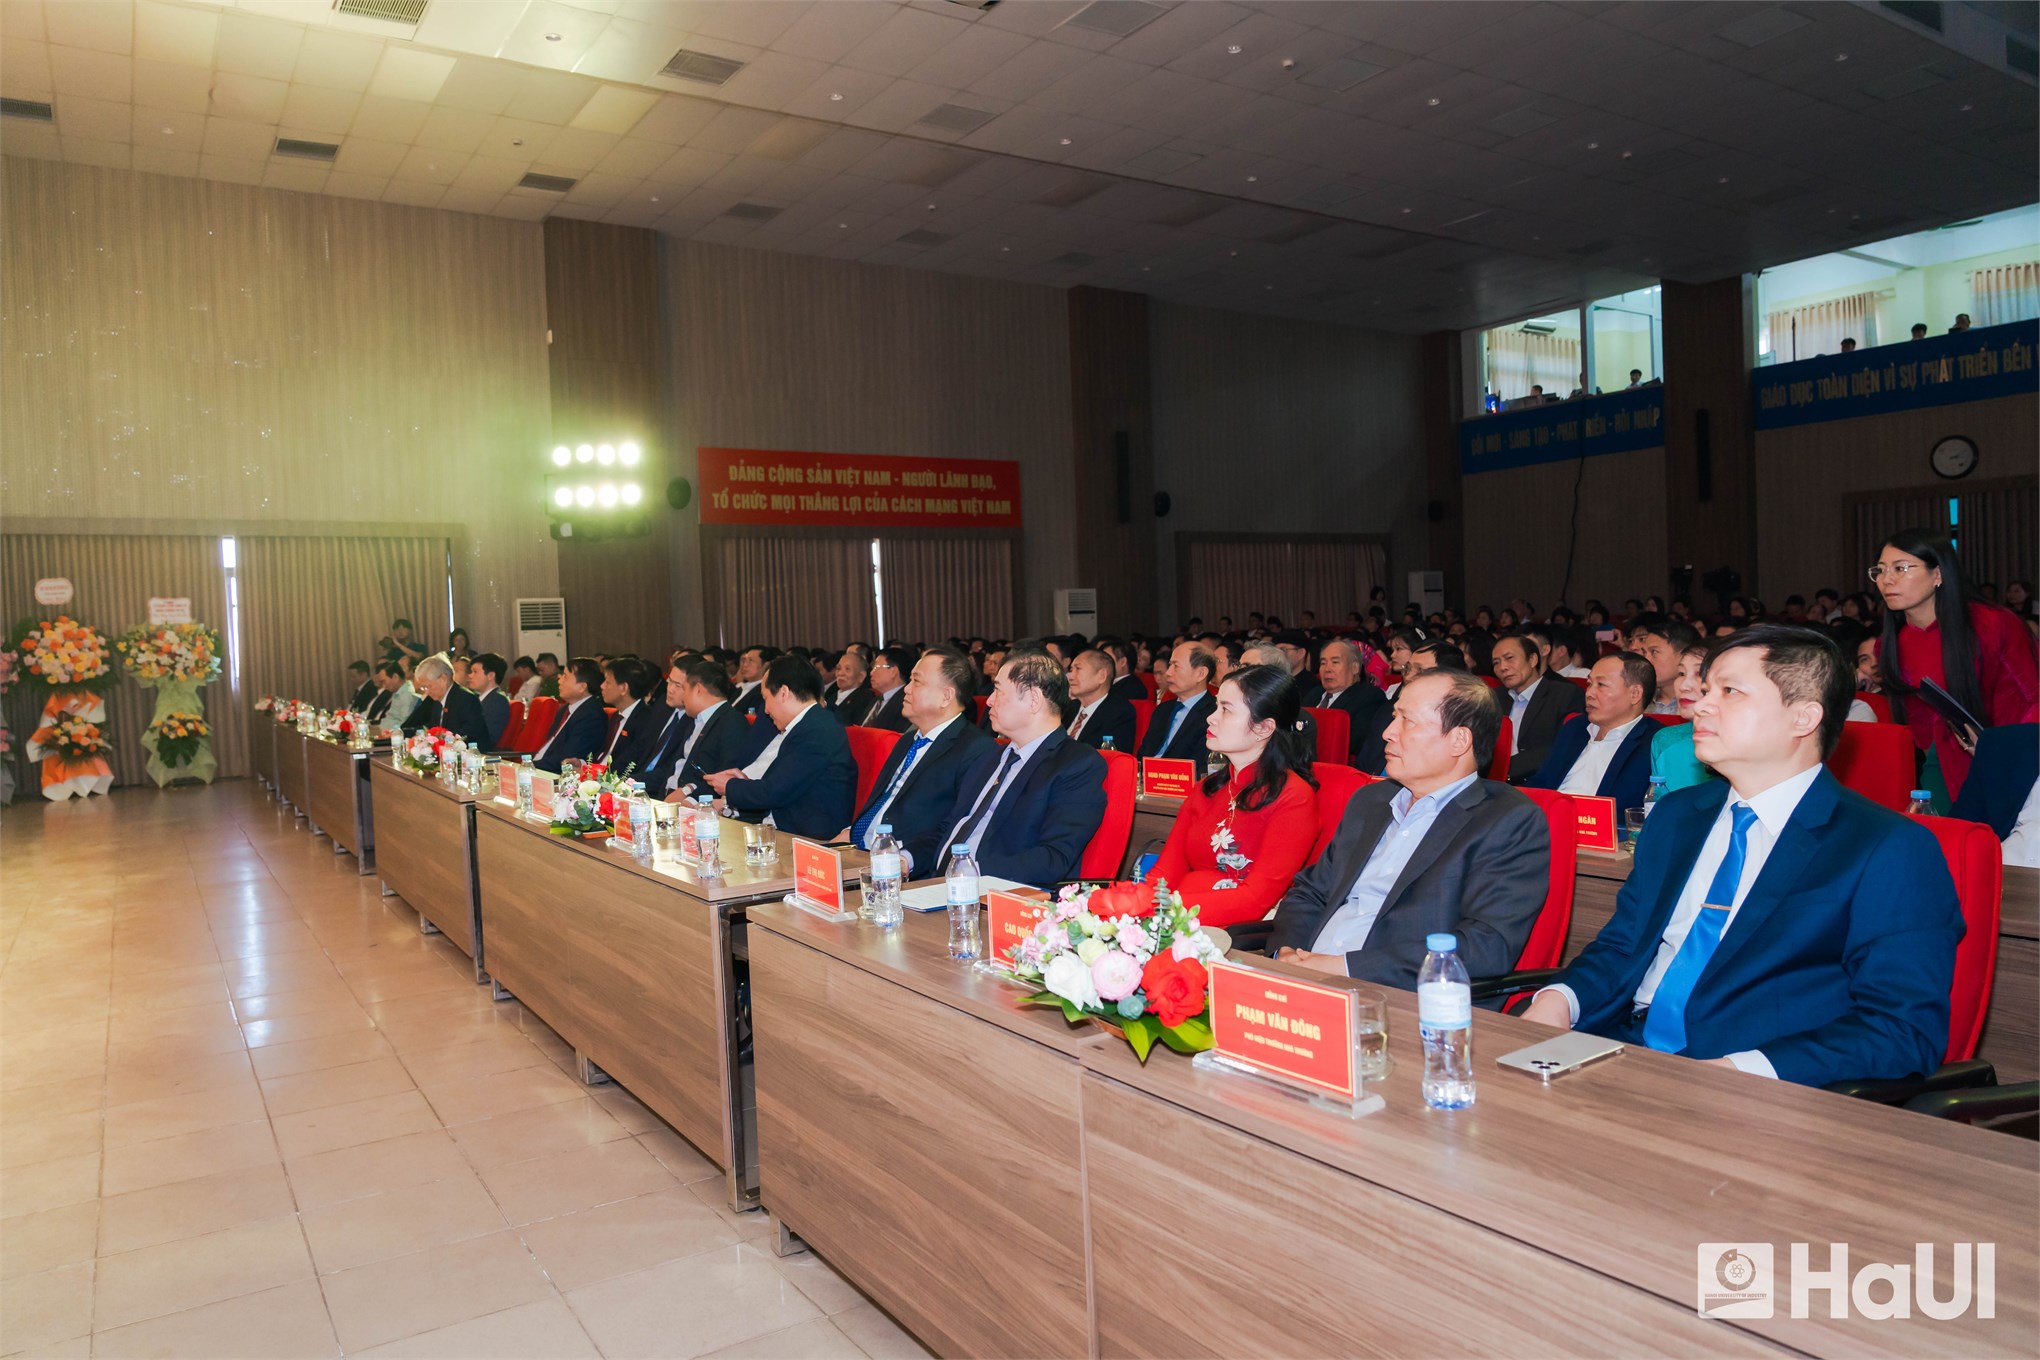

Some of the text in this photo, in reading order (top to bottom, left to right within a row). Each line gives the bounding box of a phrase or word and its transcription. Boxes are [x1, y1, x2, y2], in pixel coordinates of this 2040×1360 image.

[1817, 372, 1848, 400] TOÀN
[1851, 366, 1880, 398] DIỆN
[1883, 362, 1896, 391] VÌ
[1899, 360, 1918, 391] SỰ
[1921, 354, 1954, 385] PHÁT
[1958, 341, 1998, 380] TRIỂN
[728, 459, 765, 482] ĐẢNG
[768, 464, 803, 486] CỘNG
[806, 462, 832, 484] SẢN
[835, 466, 861, 488] VIỆT
[863, 470, 891, 486] NAM
[902, 469, 937, 488] NGƯỜI
[940, 470, 968, 488] LÃNH
[712, 487, 1011, 517] TỔ CHỨC MỌI THẮNG LỢI CỦA CÁCH MẠNG VIỆT NAM
[1004, 921, 1016, 935] CAO
[1235, 1003, 1265, 1025] PHẠM
[1267, 1011, 1289, 1032] VĂN
